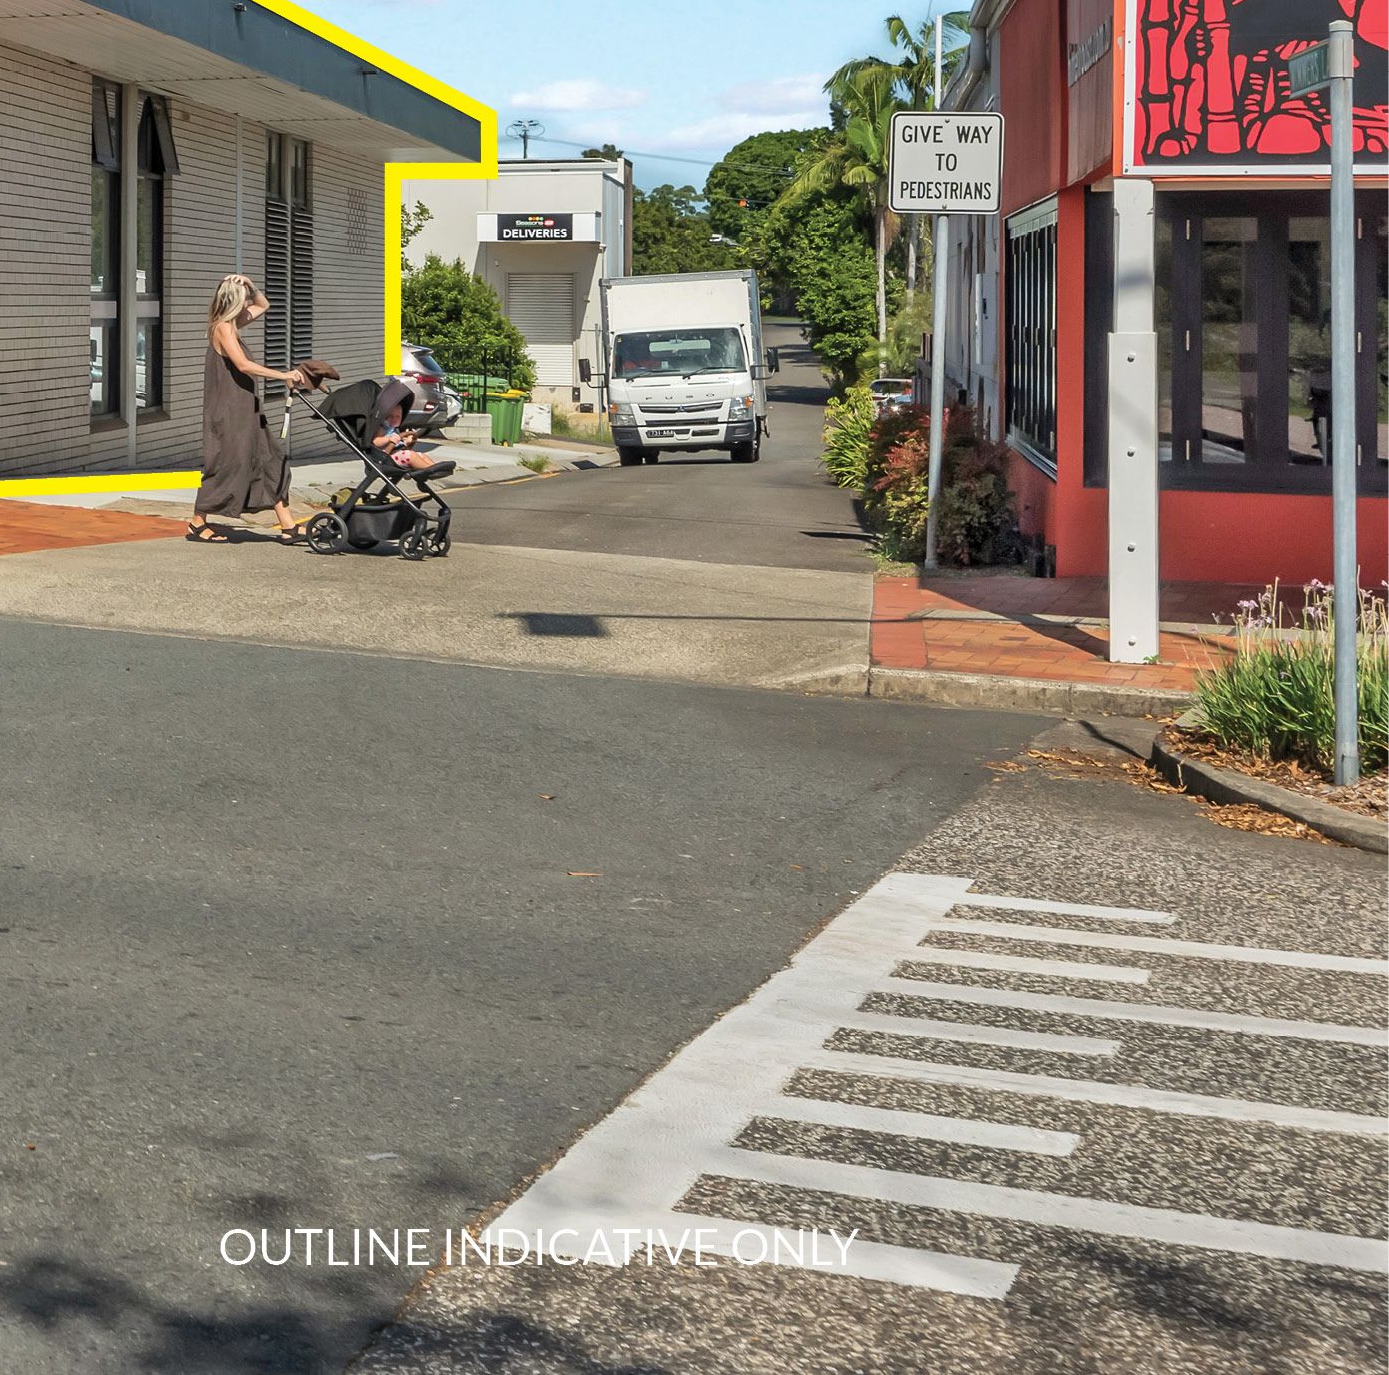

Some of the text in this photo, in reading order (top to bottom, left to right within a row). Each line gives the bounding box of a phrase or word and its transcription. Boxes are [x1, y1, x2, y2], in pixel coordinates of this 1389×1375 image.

[902, 125, 992, 144] GIVE WAY
[935, 153, 957, 171] TO
[900, 181, 991, 200] PEDESTRIANS
[503, 228, 567, 238] DELIVERIES
